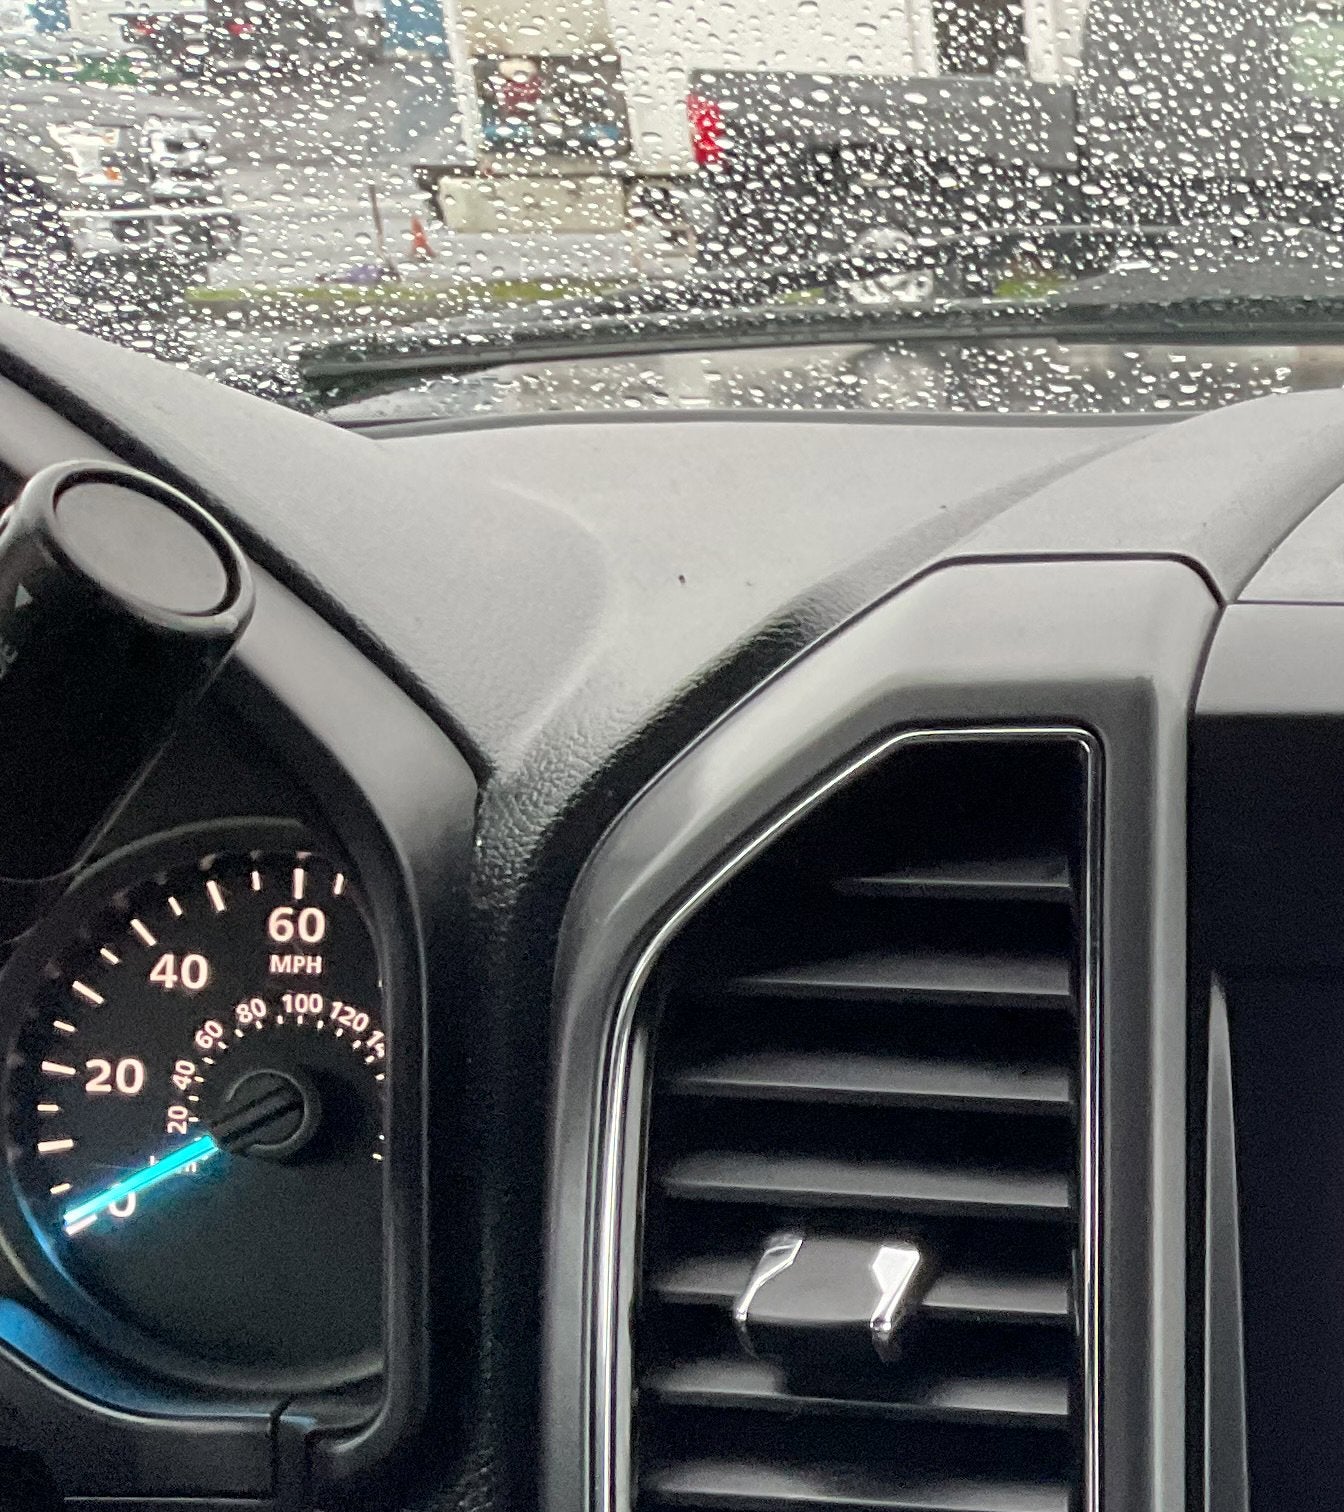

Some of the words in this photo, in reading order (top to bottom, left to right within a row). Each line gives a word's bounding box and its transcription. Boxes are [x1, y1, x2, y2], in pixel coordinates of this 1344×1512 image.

[269, 907, 325, 943] 60
[150, 954, 208, 990] 40
[270, 955, 322, 974] MPH
[235, 996, 268, 1024] 80
[281, 992, 324, 1014] 100
[329, 1000, 370, 1032] 120
[194, 1019, 225, 1051] 60
[86, 1058, 145, 1095] 20
[172, 1058, 197, 1092] 40
[166, 1103, 189, 1136] 20
